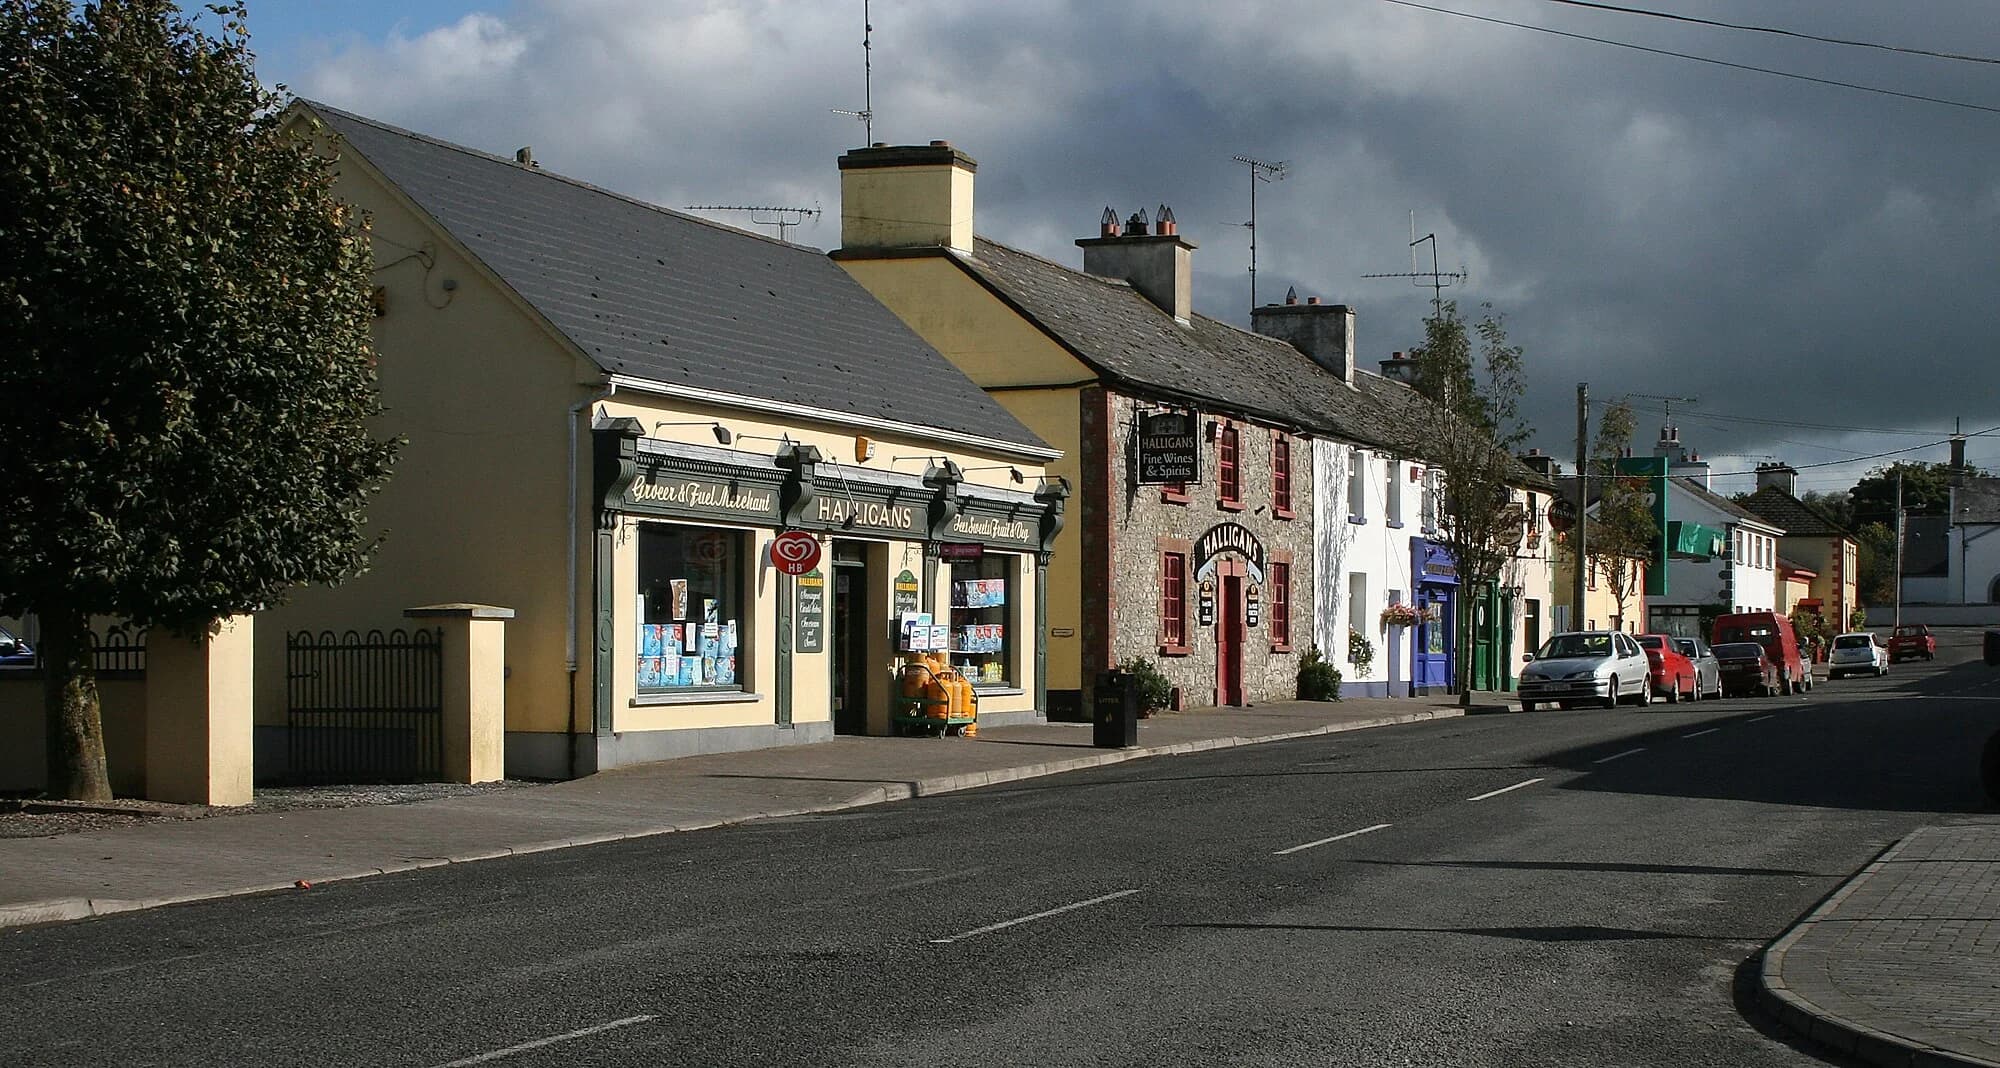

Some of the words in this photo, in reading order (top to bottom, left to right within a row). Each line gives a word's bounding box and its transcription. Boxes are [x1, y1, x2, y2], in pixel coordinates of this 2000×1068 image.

[1142, 436, 1194, 449] HALLIGANS
[1143, 453, 1162, 464] Fine
[1163, 453, 1194, 464] Wines
[1146, 465, 1158, 477] &
[1160, 465, 1191, 479] Spirits
[632, 475, 678, 503] Grocer
[678, 484, 686, 503] &
[686, 483, 716, 507] Fuel
[716, 484, 770, 511] Merchant
[818, 497, 912, 529] HALLIGANS
[991, 518, 1009, 538] Fruit
[1015, 521, 1029, 543] Veg
[1203, 526, 1258, 561] HALLIGANS
[788, 563, 803, 573] HB
